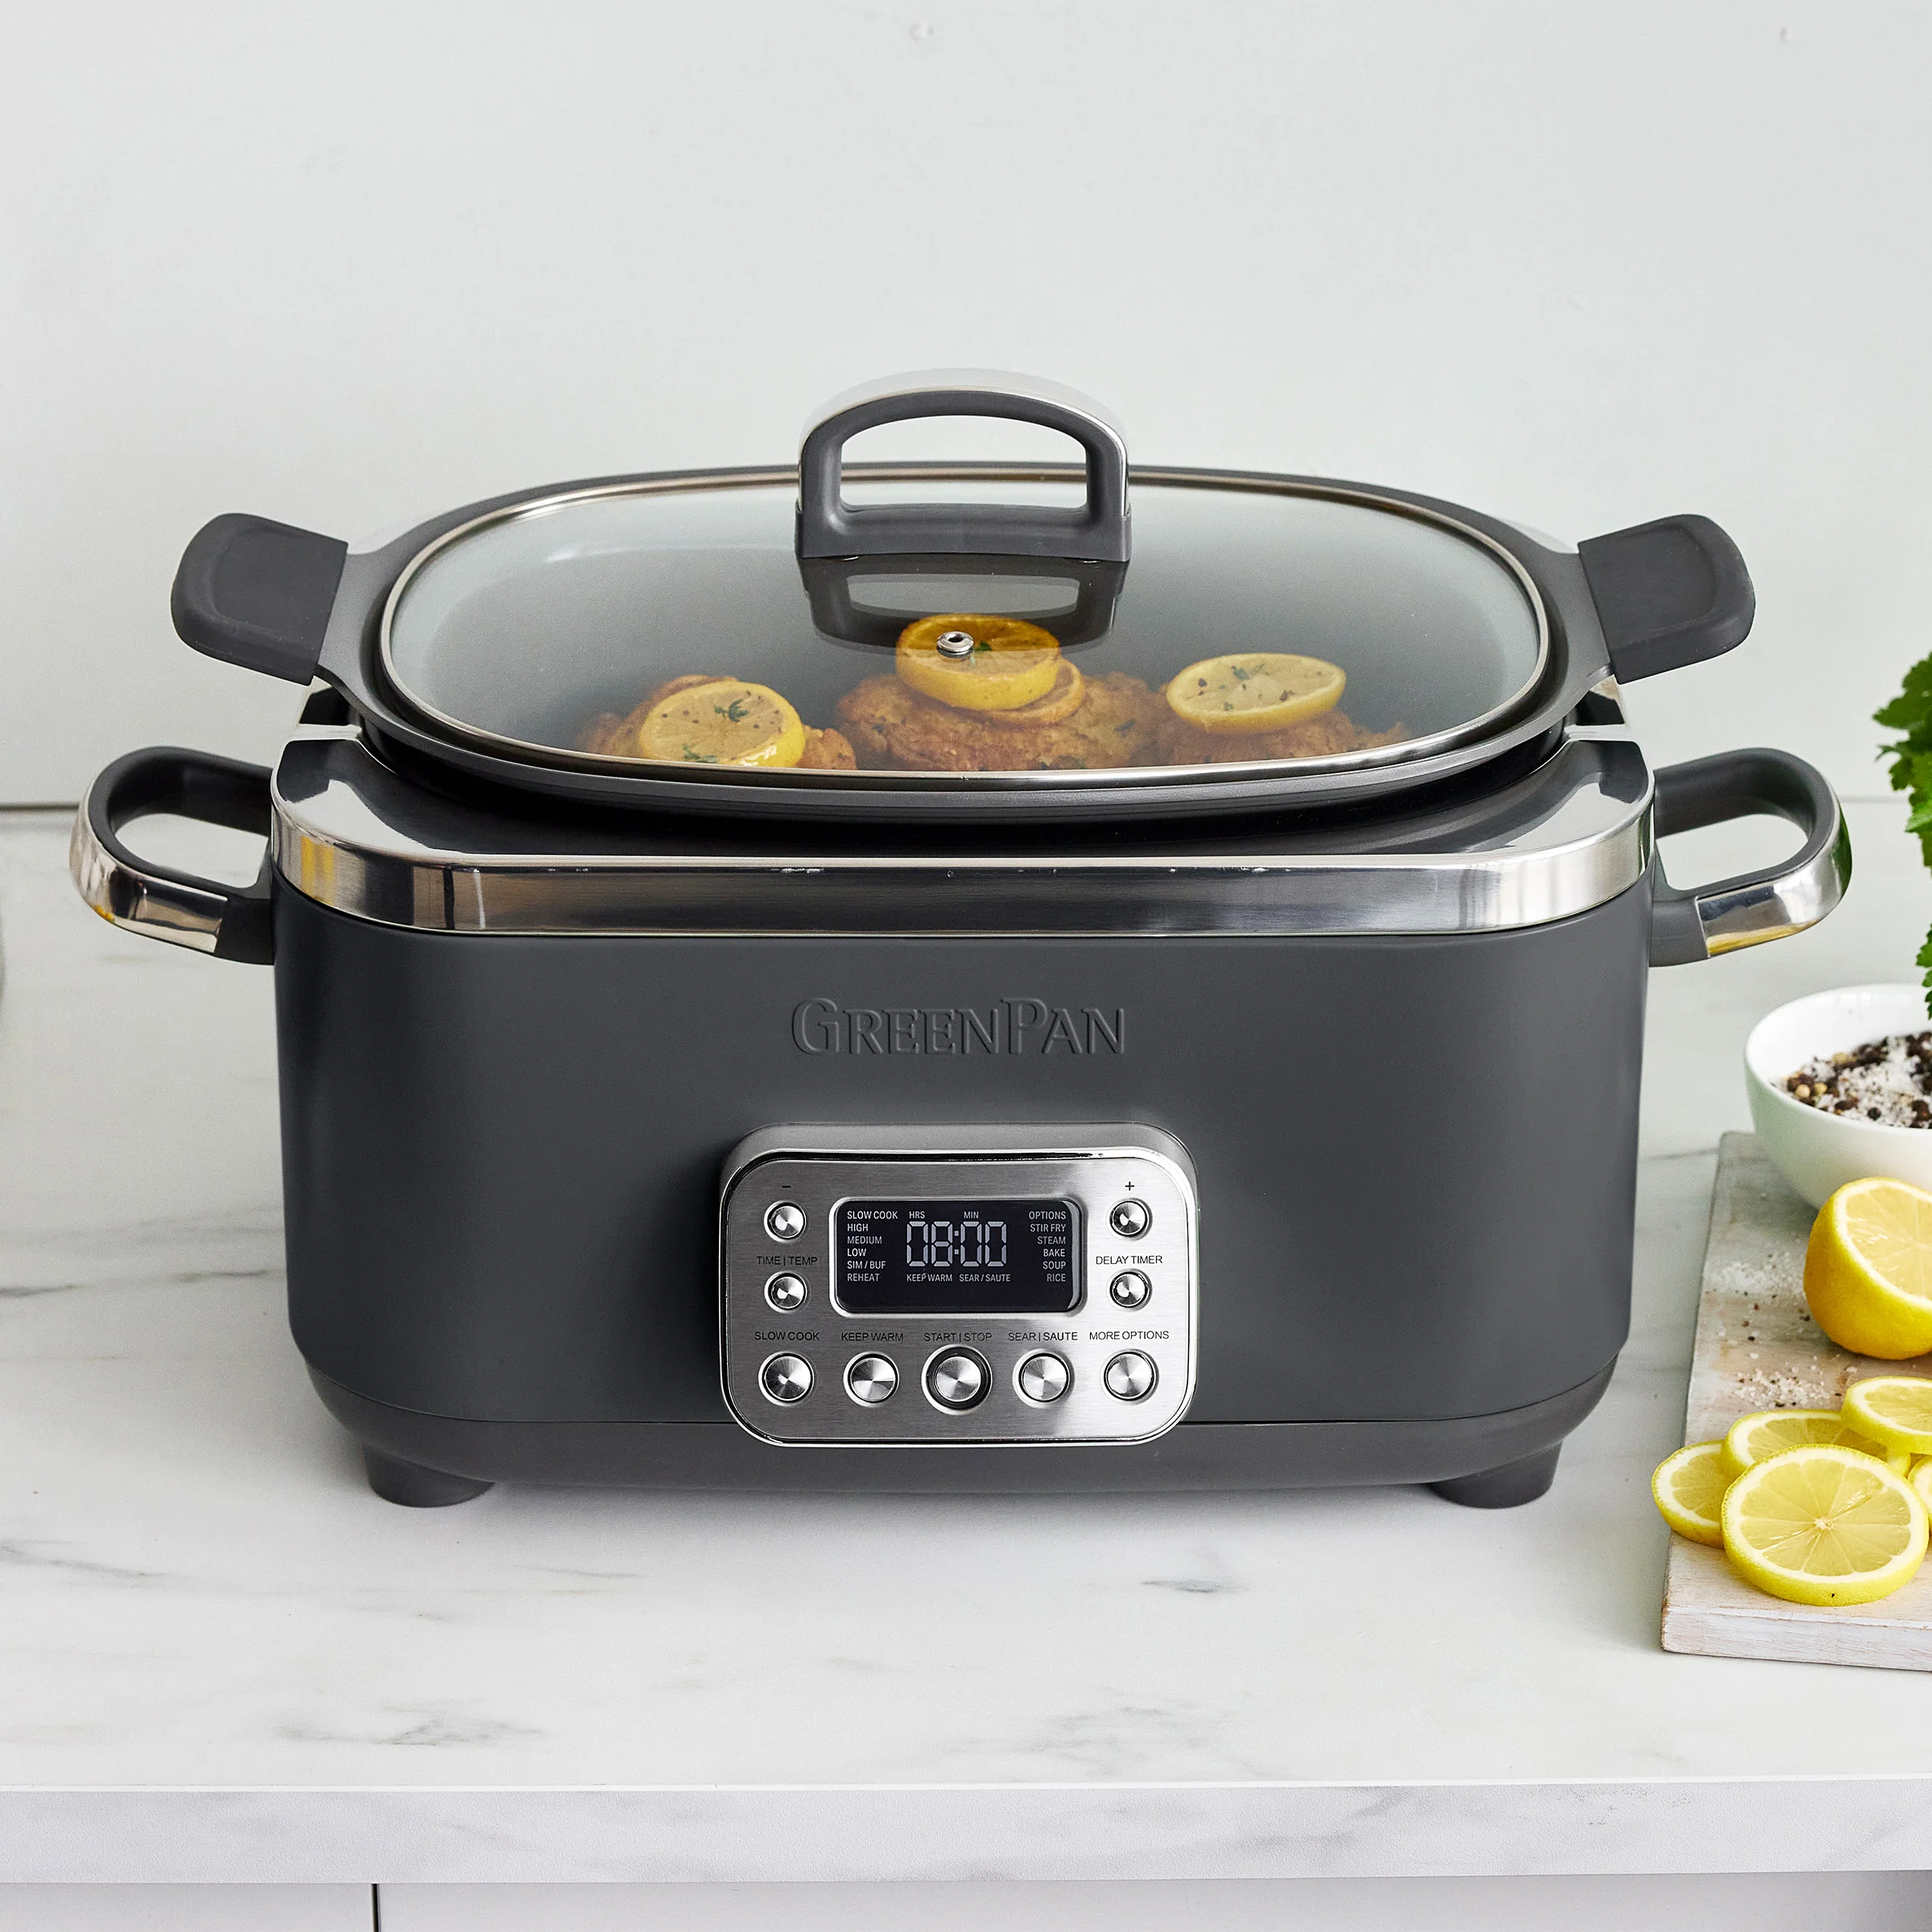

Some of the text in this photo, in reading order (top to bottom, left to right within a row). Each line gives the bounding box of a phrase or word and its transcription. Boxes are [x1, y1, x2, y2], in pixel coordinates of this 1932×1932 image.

[847, 1211, 898, 1220] SLOW COOK
[909, 1211, 926, 1220] HRS
[964, 1211, 980, 1220] MIN
[1028, 1211, 1067, 1220] OPTIONS
[847, 1224, 869, 1232] HIGH
[1030, 1224, 1067, 1232] STIR FRY
[847, 1236, 882, 1245] MEDIUM
[906, 1220, 1007, 1267] 08:00
[1037, 1236, 1066, 1245] STEAM
[847, 1248, 867, 1257] LOW
[1043, 1249, 1066, 1257] BAKE
[756, 1256, 781, 1265] TIME
[789, 1256, 818, 1265] TEMP
[1096, 1255, 1163, 1265] DELAY TIMER
[847, 1261, 863, 1269] SIM
[869, 1261, 886, 1269] BUF
[1042, 1261, 1067, 1269] SOUP
[847, 1273, 880, 1282] REHEAT
[906, 1274, 953, 1282] KEEP WARM
[959, 1274, 980, 1282] SEAR
[985, 1274, 1011, 1282] SAUTE
[1046, 1273, 1067, 1282] RICE
[754, 1331, 820, 1340] SLOW COOK
[841, 1332, 904, 1342] KEEP WARM
[923, 1332, 957, 1341] START
[964, 1332, 993, 1342] STOP
[1008, 1332, 1037, 1341] SEAR
[1043, 1331, 1078, 1341] SAUTE
[1089, 1331, 1170, 1340] MORE OPTIONS
